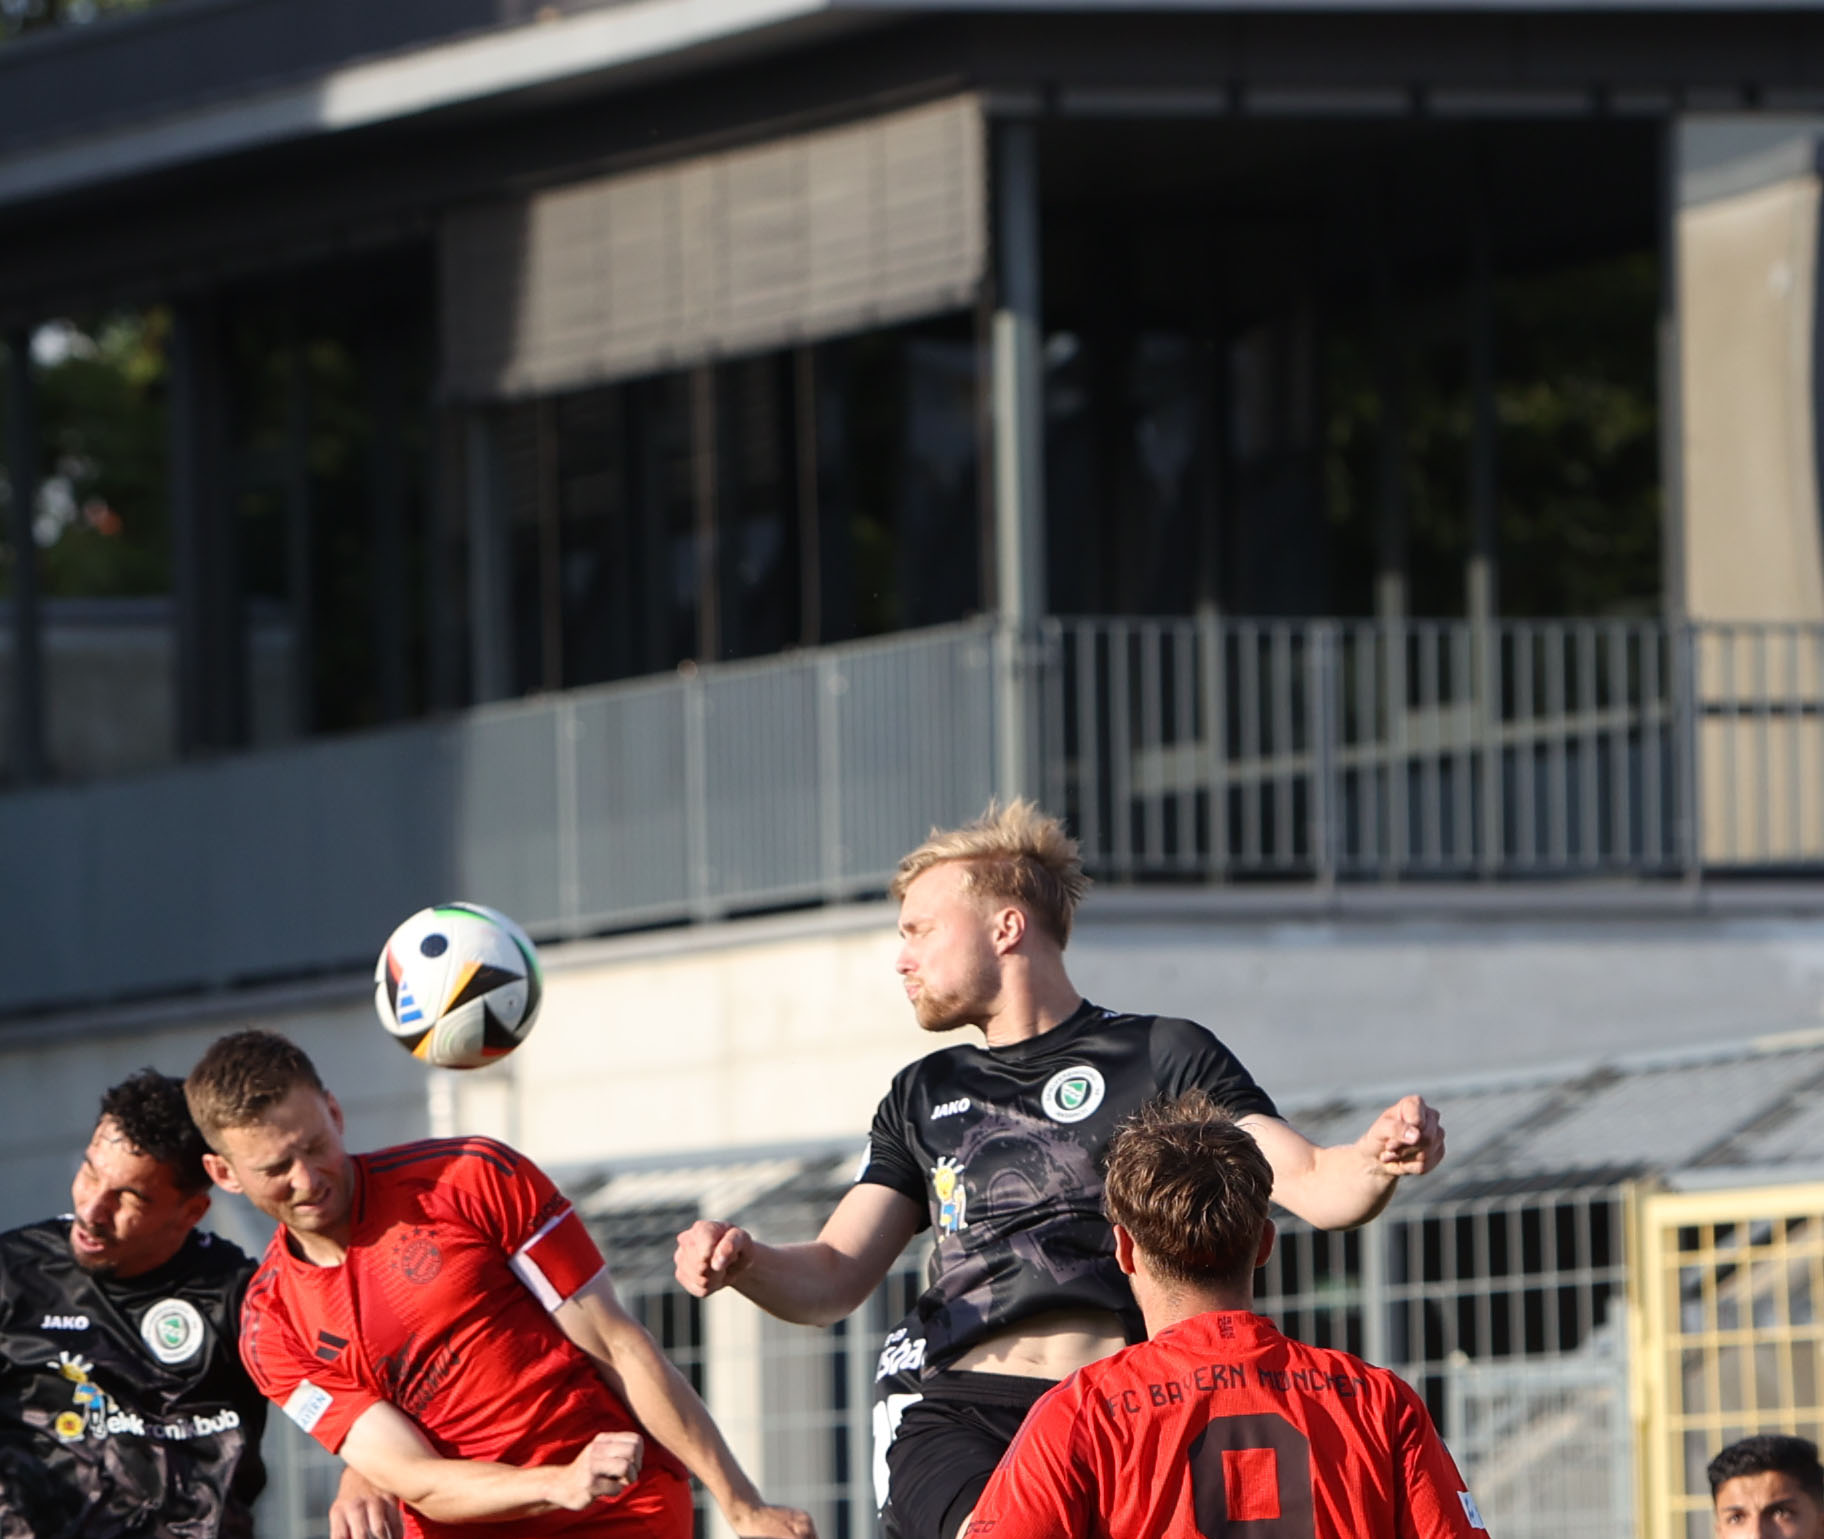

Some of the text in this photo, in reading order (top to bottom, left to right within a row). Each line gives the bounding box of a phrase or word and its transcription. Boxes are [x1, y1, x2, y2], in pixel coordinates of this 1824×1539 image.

[930, 1097, 972, 1121] JAKO
[40, 1314, 90, 1331] JAKO
[1107, 1389, 1141, 1417] FC
[1148, 1363, 1247, 1408] BAYERN
